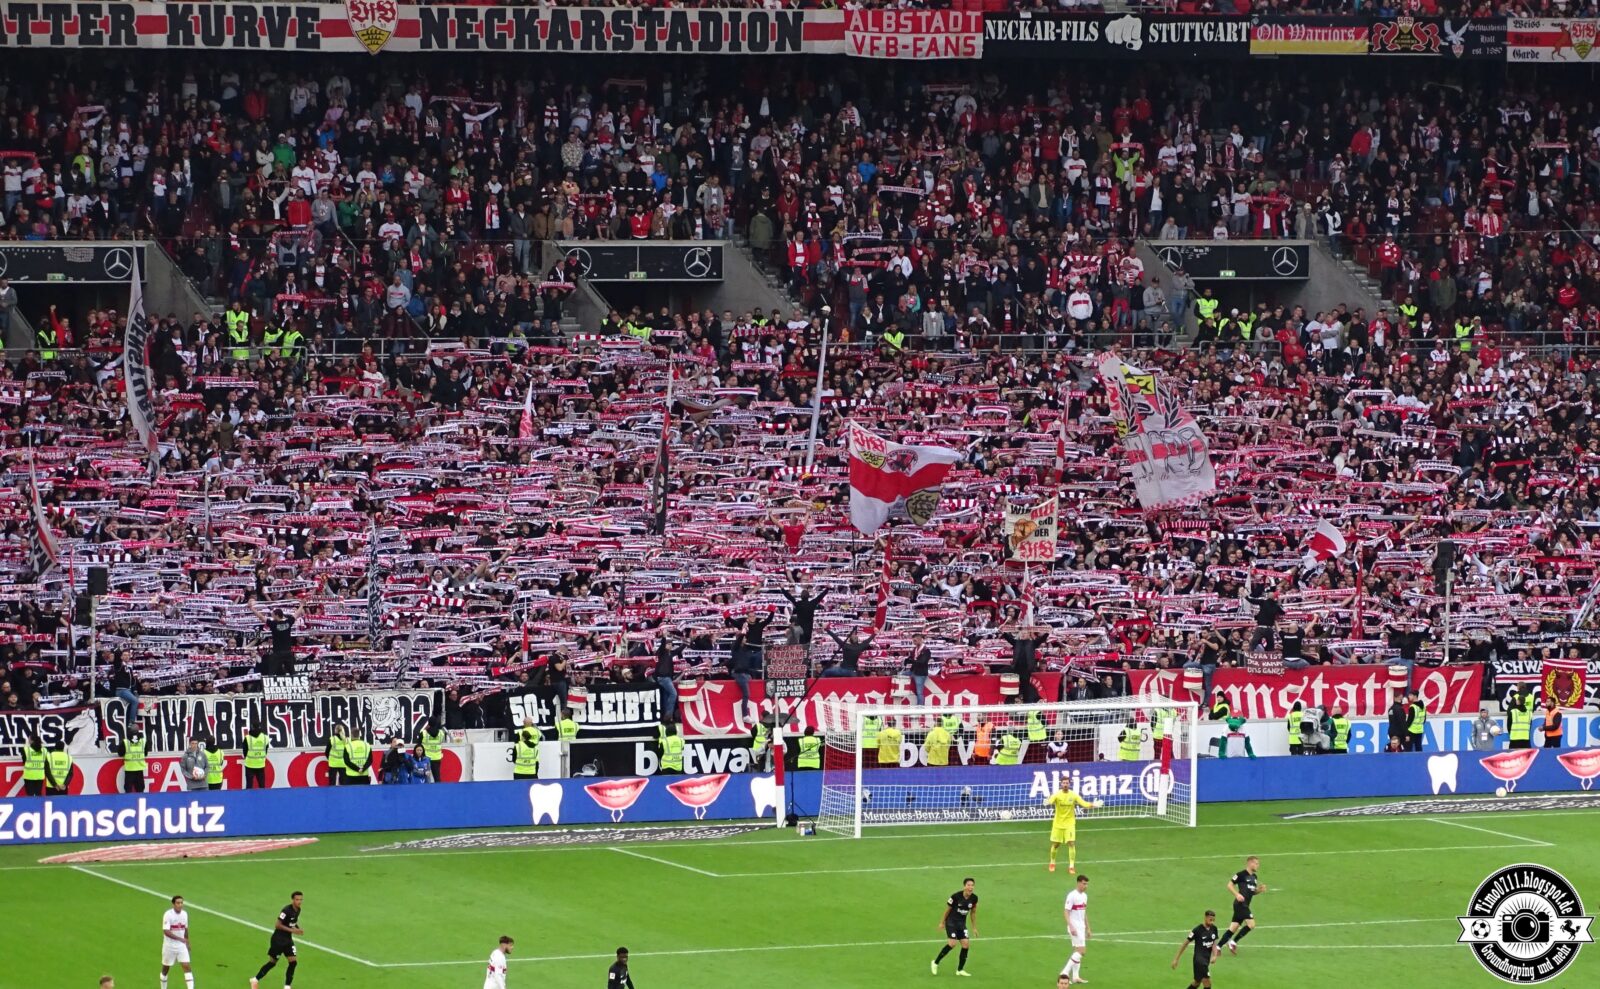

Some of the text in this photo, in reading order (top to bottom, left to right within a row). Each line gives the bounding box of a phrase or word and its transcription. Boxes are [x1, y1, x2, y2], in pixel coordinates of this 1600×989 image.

[0, 3, 803, 52] TTER KURVE NECKARSTADION
[849, 11, 982, 34] ALBSTADT
[984, 19, 1250, 43] NECKAR-FILS STUTTGART
[1257, 23, 1356, 42] Old Warriors
[851, 32, 977, 58] VFB-FANS
[1512, 48, 1540, 59] Garde
[282, 463, 318, 471] STUTTGART
[1034, 529, 1050, 538] DER
[75, 543, 116, 551] STUTTGART
[1019, 540, 1055, 560] VfB
[267, 583, 308, 593] STUTTGART
[262, 676, 309, 689] ULTRAS
[263, 685, 310, 695] BEDEUTET
[263, 692, 313, 701] WIDERSTAND
[776, 686, 808, 694] IMMER
[1416, 670, 1475, 716] 97
[1347, 717, 1600, 754] BAINOU
[0, 797, 226, 840] Zahnschutz
[863, 810, 941, 823] Mercedes-Benz
[943, 809, 970, 820] Bank
